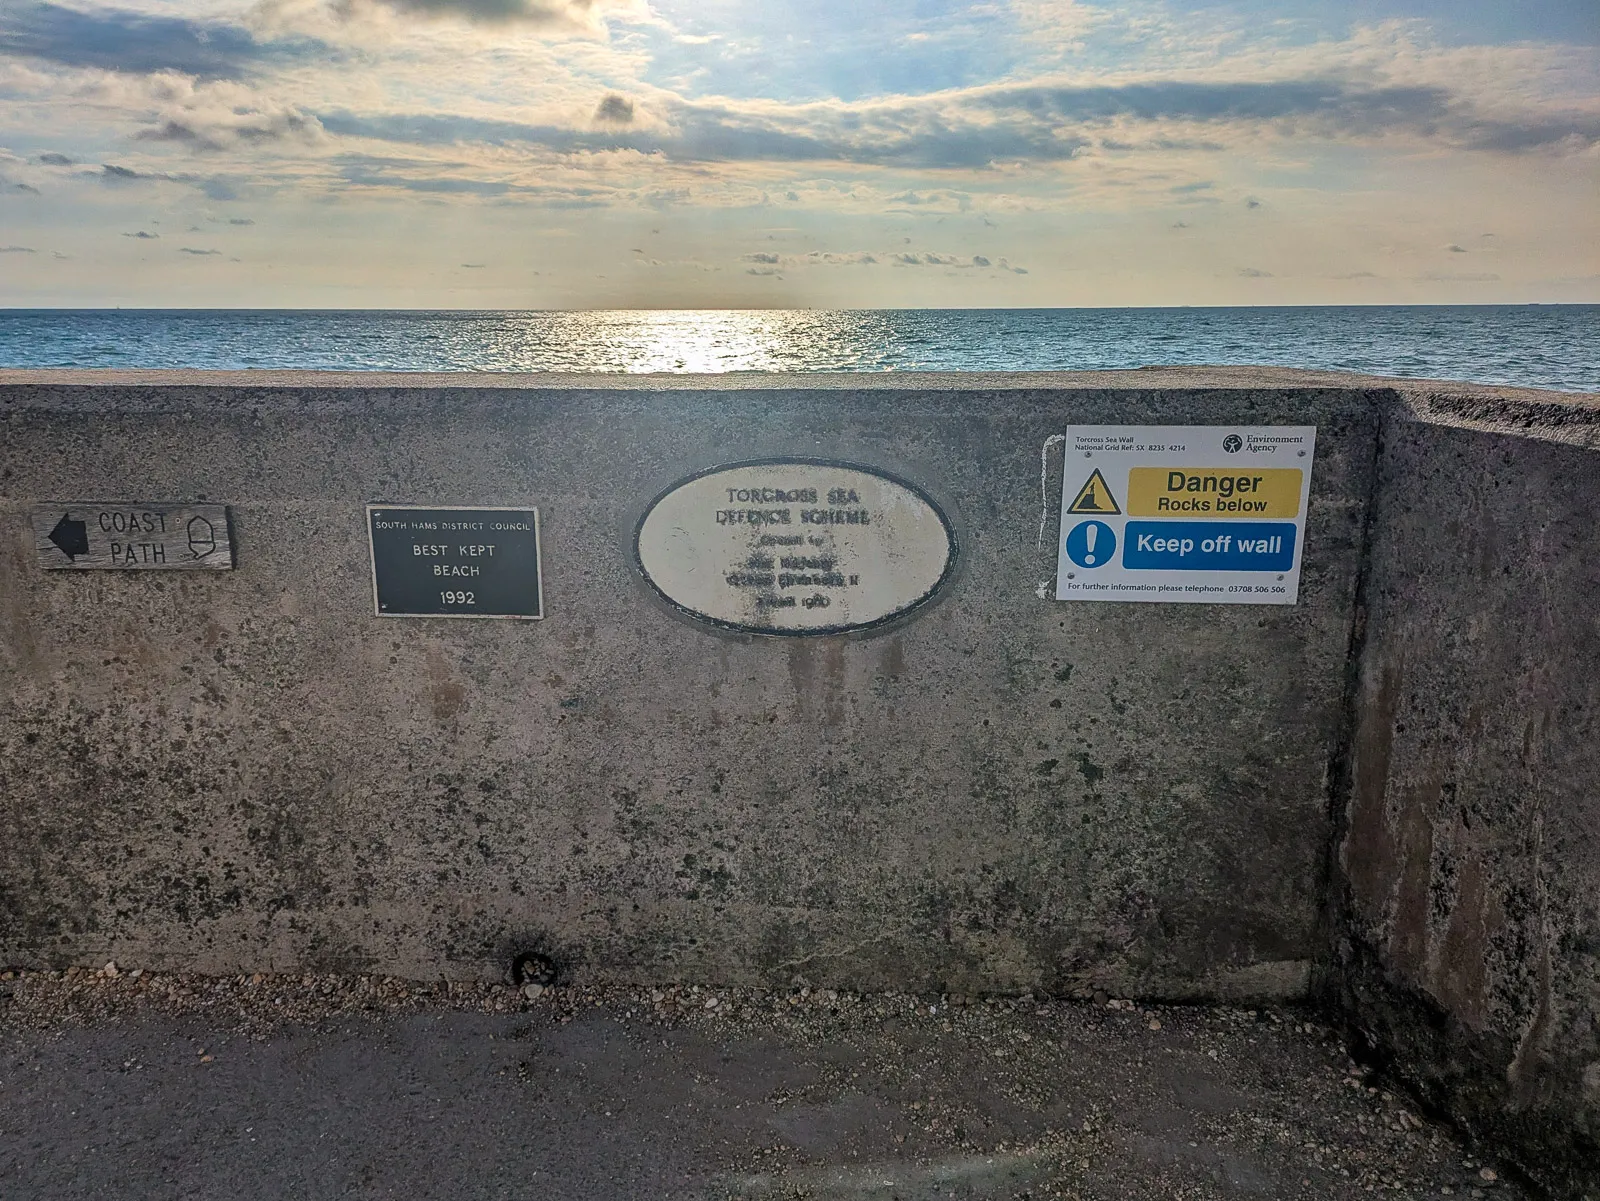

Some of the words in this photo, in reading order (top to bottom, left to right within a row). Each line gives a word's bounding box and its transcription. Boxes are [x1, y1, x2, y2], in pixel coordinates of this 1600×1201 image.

[1246, 434, 1303, 443] Environment
[1136, 444, 1145, 452] SX
[1148, 444, 1165, 452] 8235
[1169, 444, 1186, 452] 4214
[1246, 443, 1277, 453] Agency
[1167, 471, 1263, 497] Danger
[726, 487, 818, 504] TORCROSS
[827, 487, 860, 504] SEA
[1157, 497, 1211, 512] Rocks
[1216, 497, 1268, 512] below
[99, 512, 168, 533] COAST
[716, 508, 791, 525] DEFENCE
[801, 508, 870, 525] SCHEME
[375, 521, 407, 530] SOUTH
[411, 521, 438, 530] HAMS
[442, 522, 484, 530] DISTRICT
[490, 522, 531, 531] COUNCIL
[413, 544, 448, 556] BEST
[459, 545, 495, 557] KEPT
[1137, 534, 1194, 557] Keep
[1201, 535, 1233, 553] off
[1237, 536, 1282, 554] wall
[110, 542, 166, 564] PATH
[433, 565, 480, 577] BEACH
[1067, 582, 1081, 590] For
[1082, 582, 1110, 590] further
[1111, 583, 1157, 591] information
[1158, 583, 1183, 592] please
[1184, 584, 1225, 593] telephone
[1228, 585, 1253, 593] 03708
[1254, 585, 1269, 593] 506
[1270, 585, 1286, 593] 506
[440, 591, 476, 604] 1992
